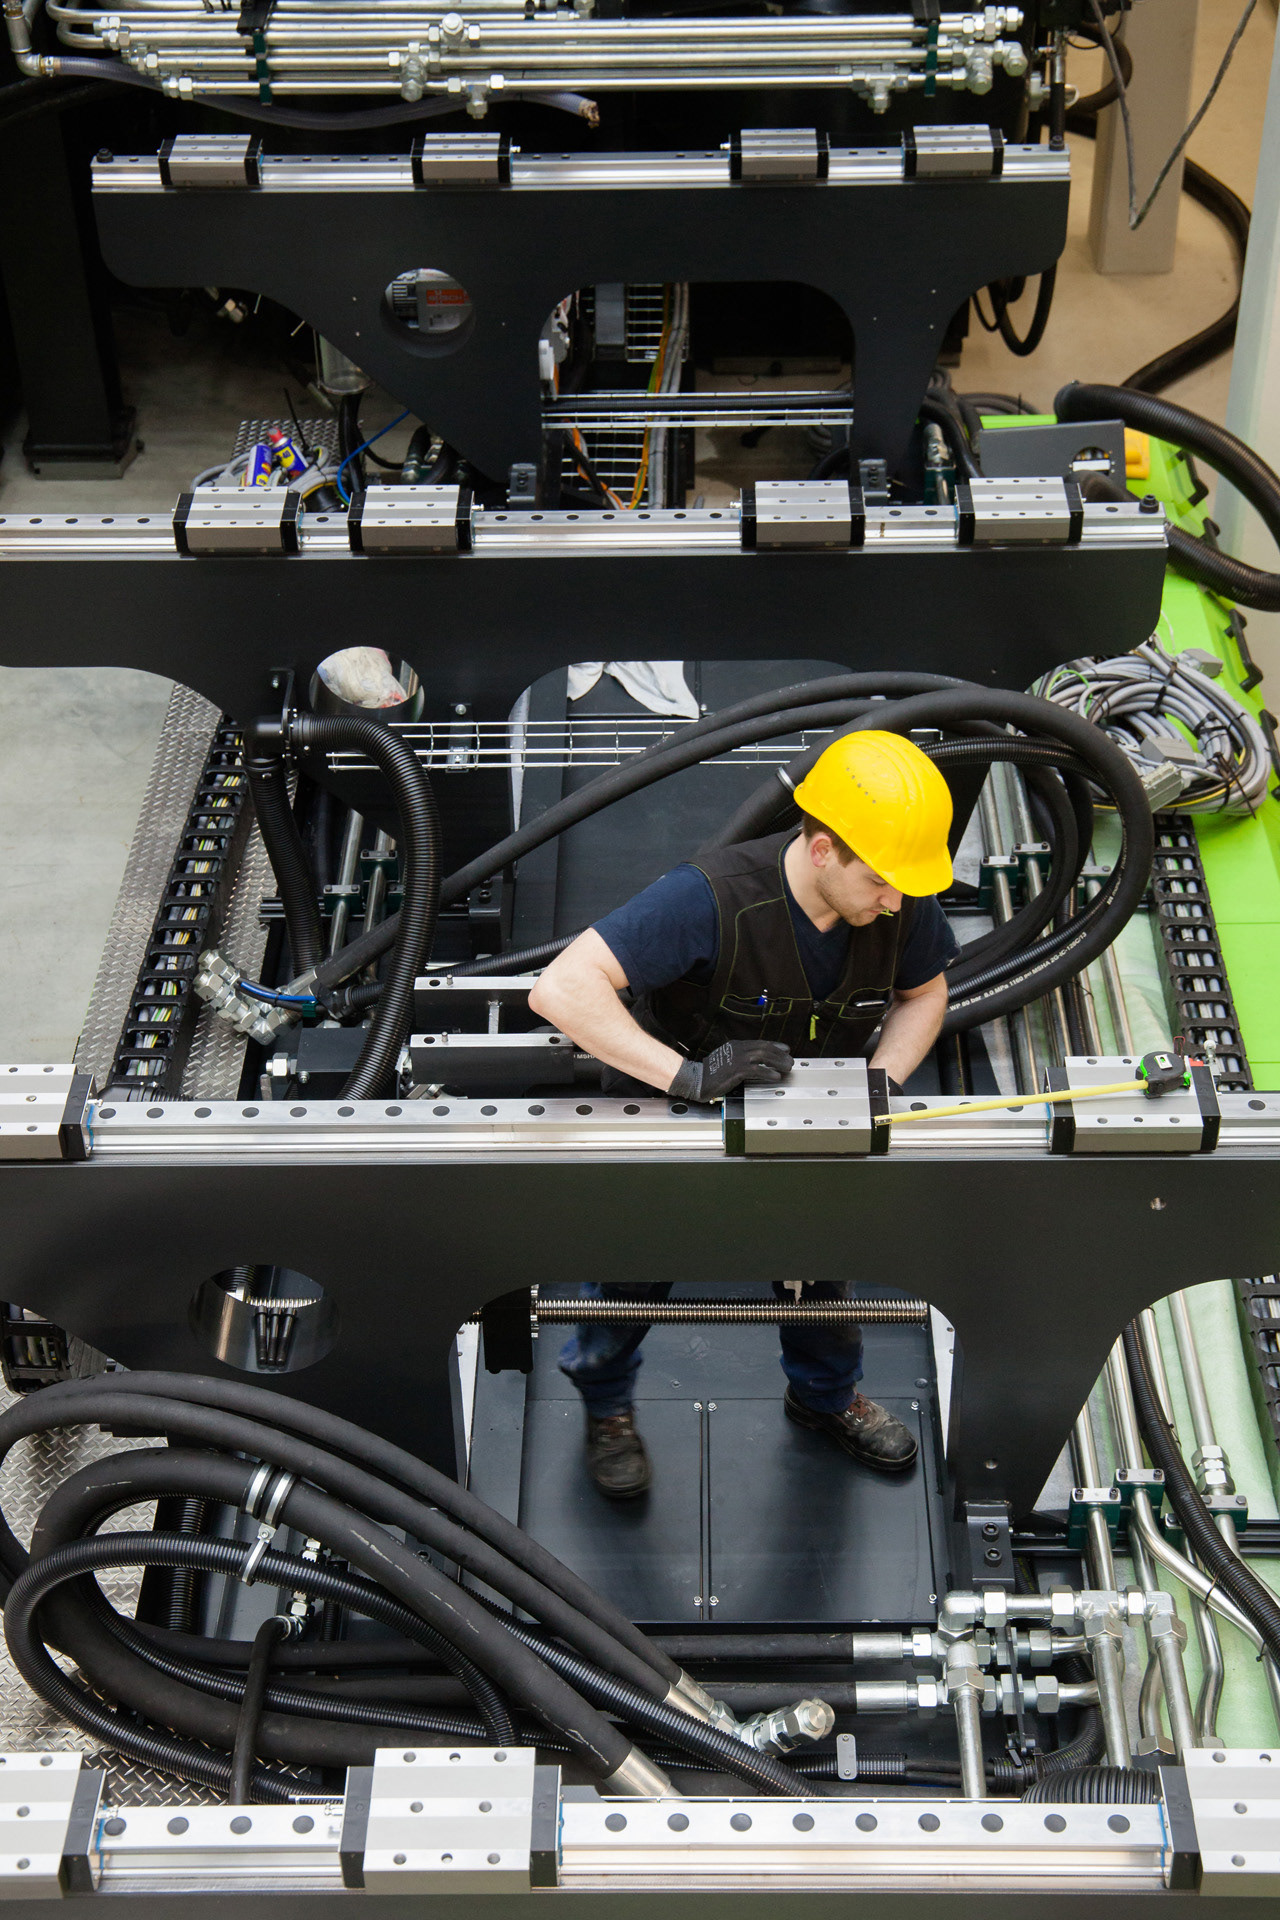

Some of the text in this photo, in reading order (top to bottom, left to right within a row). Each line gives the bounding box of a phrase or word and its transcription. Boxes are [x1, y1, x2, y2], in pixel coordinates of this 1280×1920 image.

[949, 1003, 961, 1011] WP
[970, 995, 982, 1003] bar
[994, 984, 1009, 994] MPa
[1023, 971, 1032, 980] psi
[1031, 960, 1051, 975] MSHA
